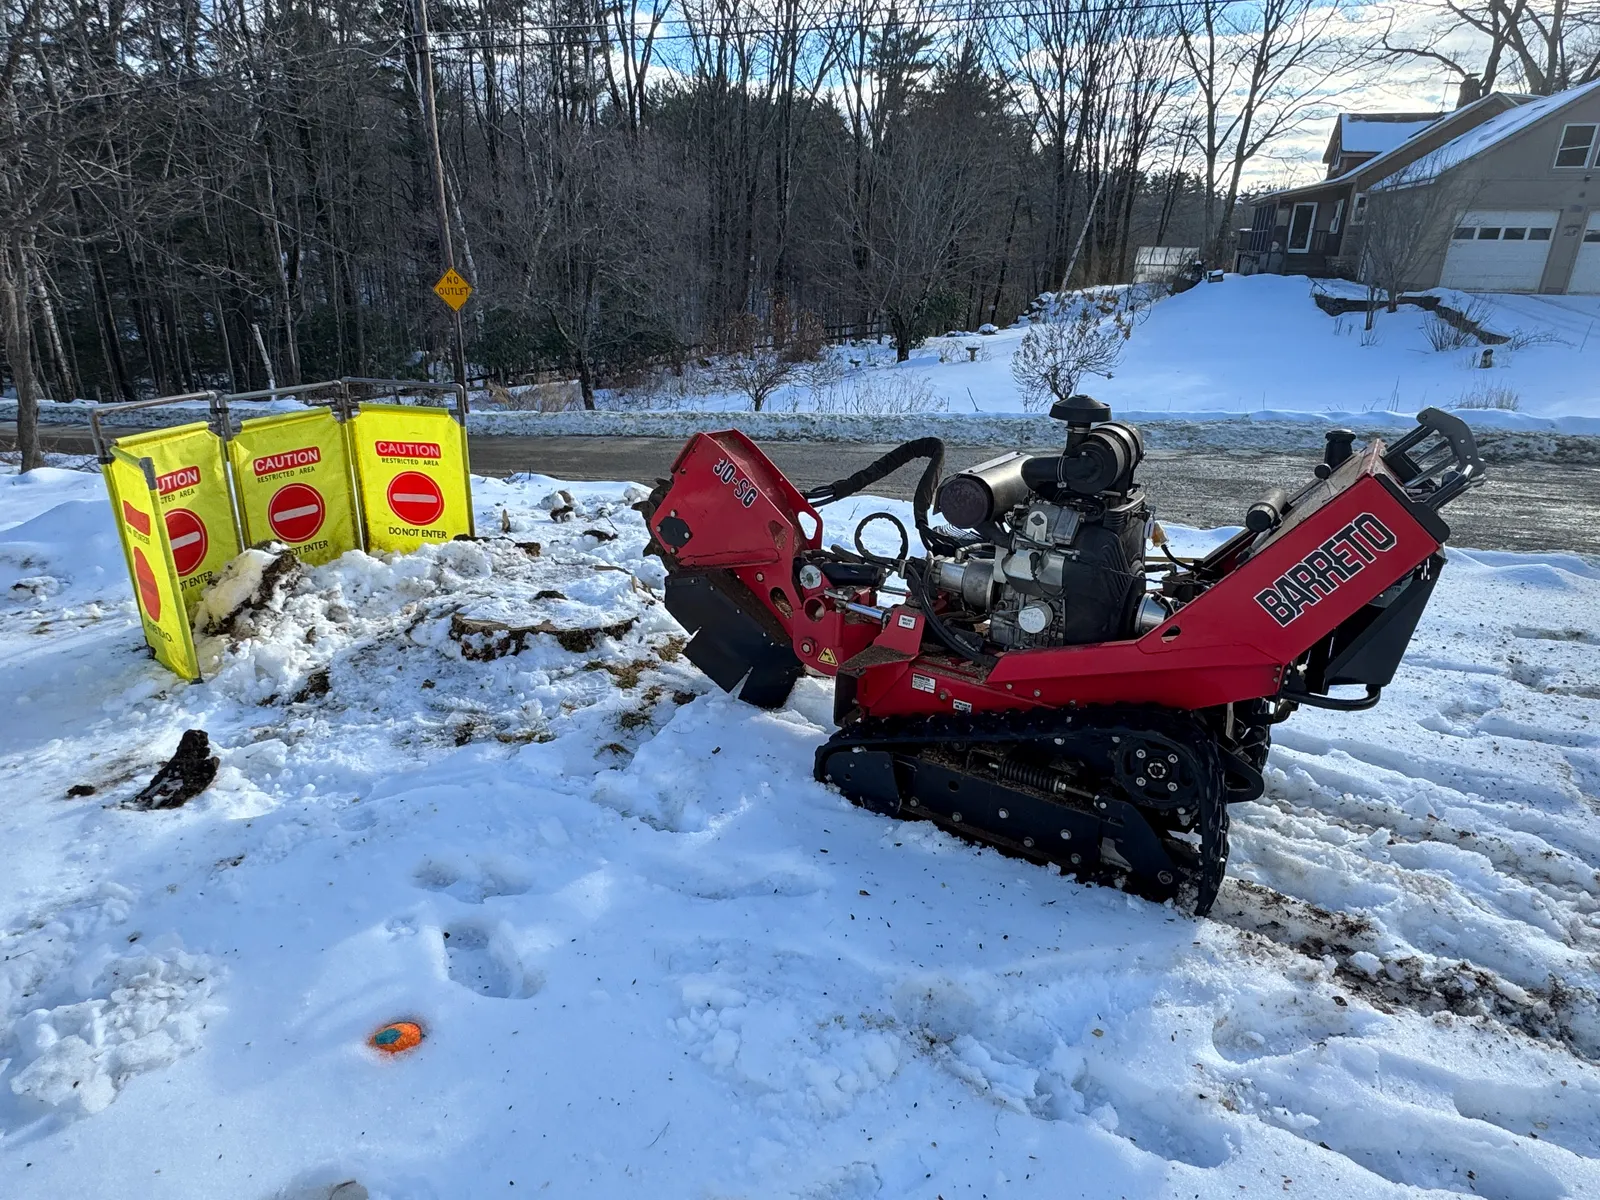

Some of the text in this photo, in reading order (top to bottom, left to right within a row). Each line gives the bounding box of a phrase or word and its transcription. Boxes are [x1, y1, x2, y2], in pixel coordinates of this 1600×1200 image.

[446, 276, 459, 285] NO
[438, 287, 469, 296] OUTLET
[377, 442, 440, 457] CAUTION
[255, 449, 319, 472] CAUTION
[381, 457, 440, 467] RESTRICTED AREA
[156, 469, 198, 492] UTION
[257, 465, 316, 484] RESTRICTED AREA
[712, 457, 759, 509] 30-SG
[180, 488, 196, 499] AREA
[421, 529, 448, 539] ENTER
[291, 540, 329, 556] OT ENTER
[1253, 512, 1397, 628] BARRETO
